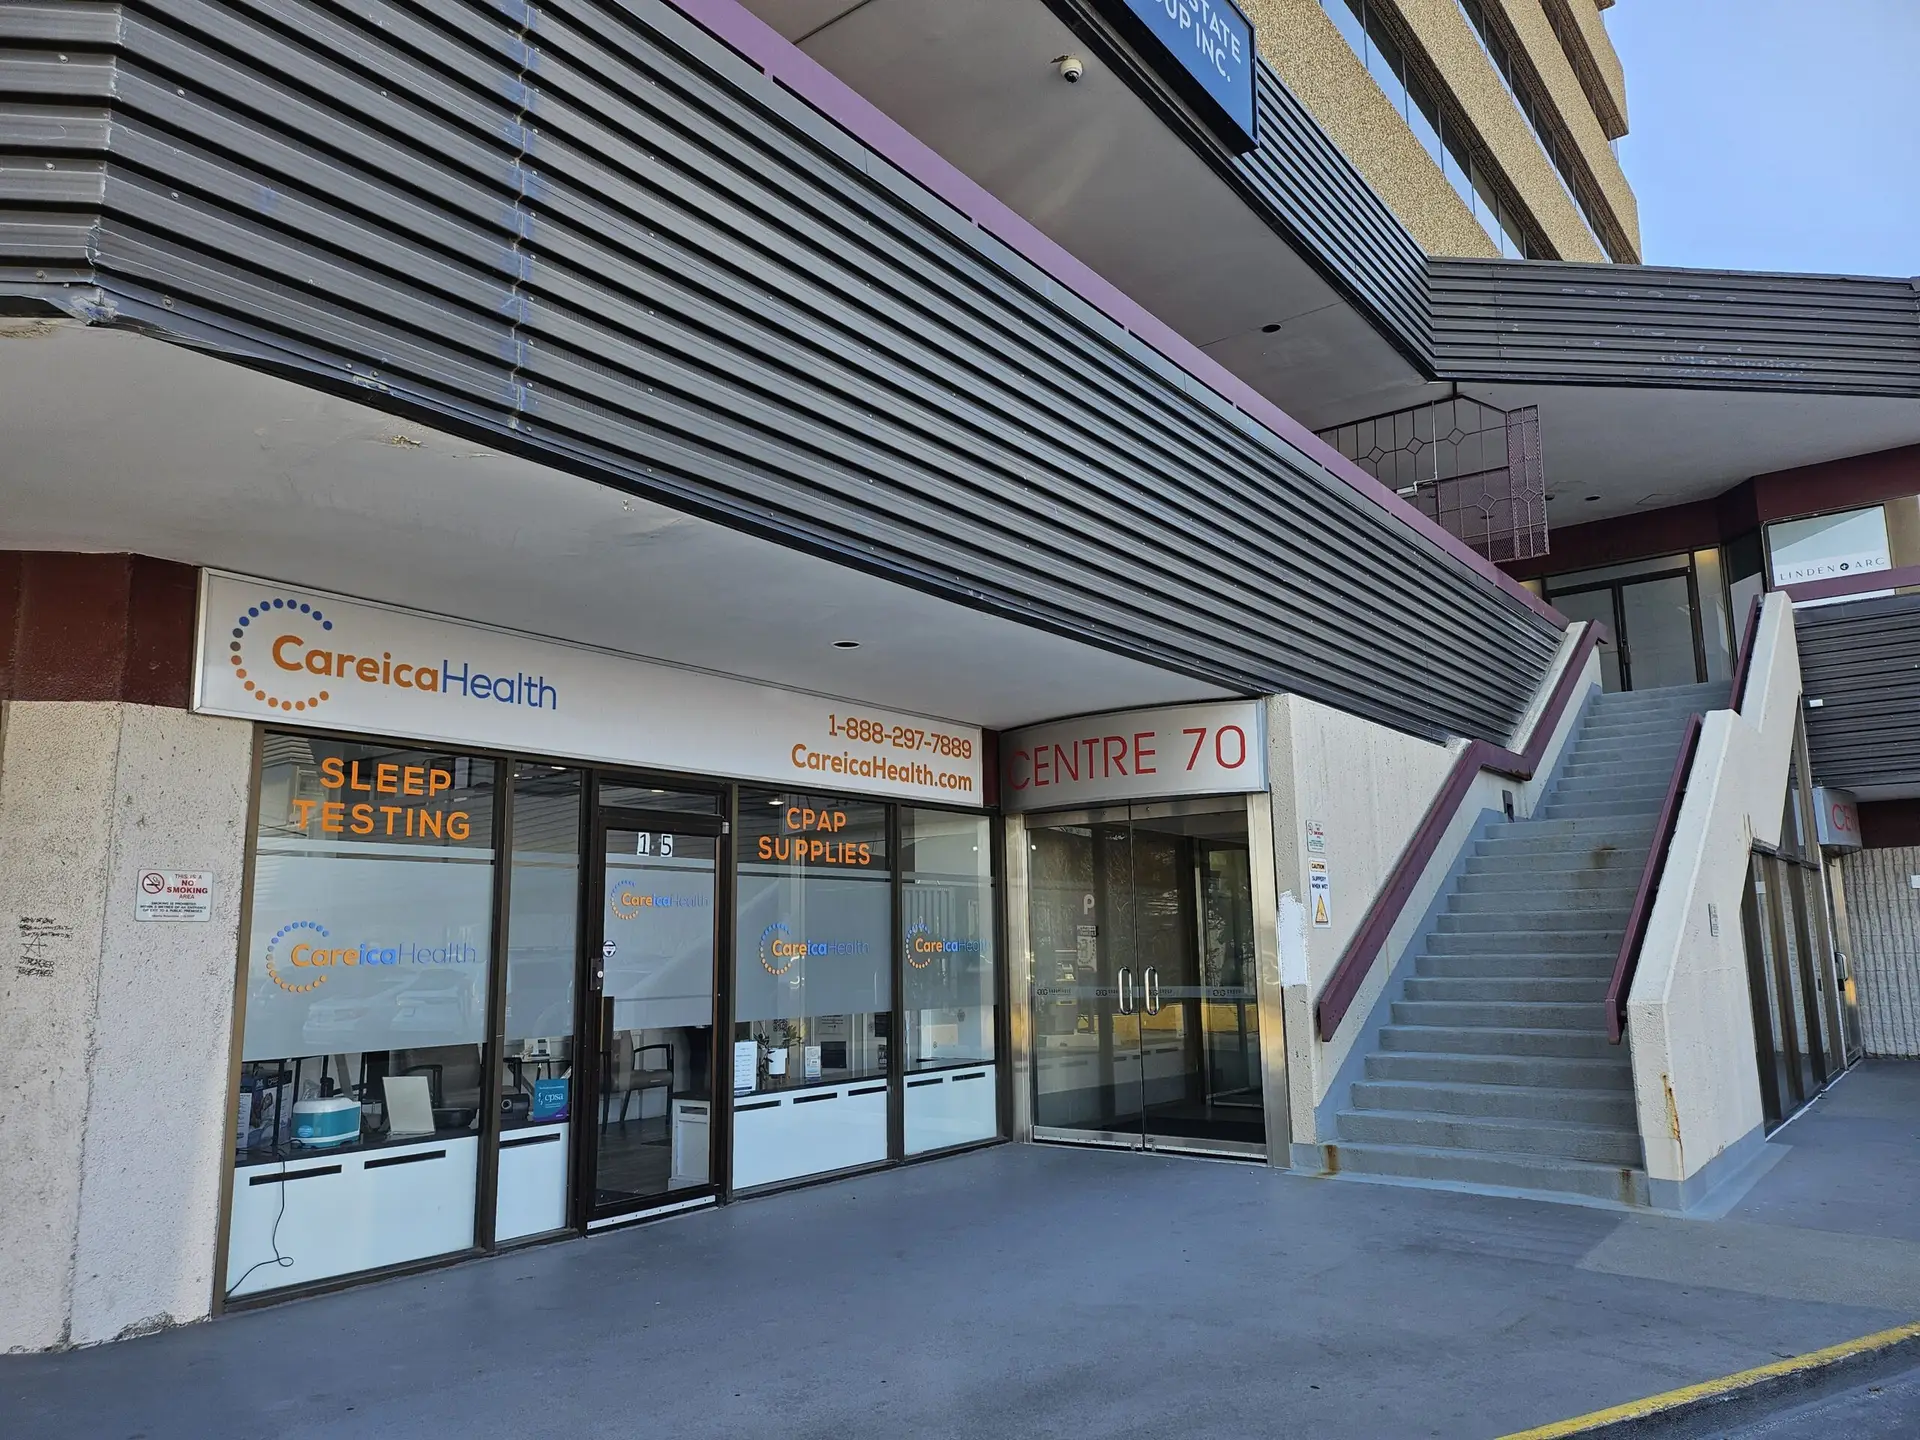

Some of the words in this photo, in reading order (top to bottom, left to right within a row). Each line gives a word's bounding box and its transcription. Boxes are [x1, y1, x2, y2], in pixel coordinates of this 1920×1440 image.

[1156, 0, 1191, 29] UP
[1195, 21, 1231, 83] INC.
[1779, 564, 1835, 581] LINDEN
[1854, 557, 1885, 569] ARC
[271, 634, 557, 710] CareicaHealth
[828, 713, 972, 760] 1-888-297-7889
[791, 743, 973, 792] CareicaHealth.com
[1007, 731, 1157, 790] CENTRE
[1182, 725, 1246, 771] 70
[319, 756, 452, 797] SLEEP
[292, 799, 471, 841] TESTING
[786, 806, 847, 833] CPAP
[758, 835, 871, 866] SUPPLIES
[166, 886, 208, 894] SMOKING
[181, 879, 195, 887] NO
[621, 891, 709, 908] CareicaHealth
[290, 941, 476, 967] CareicaHealth
[544, 1092, 564, 1103] cpsa
